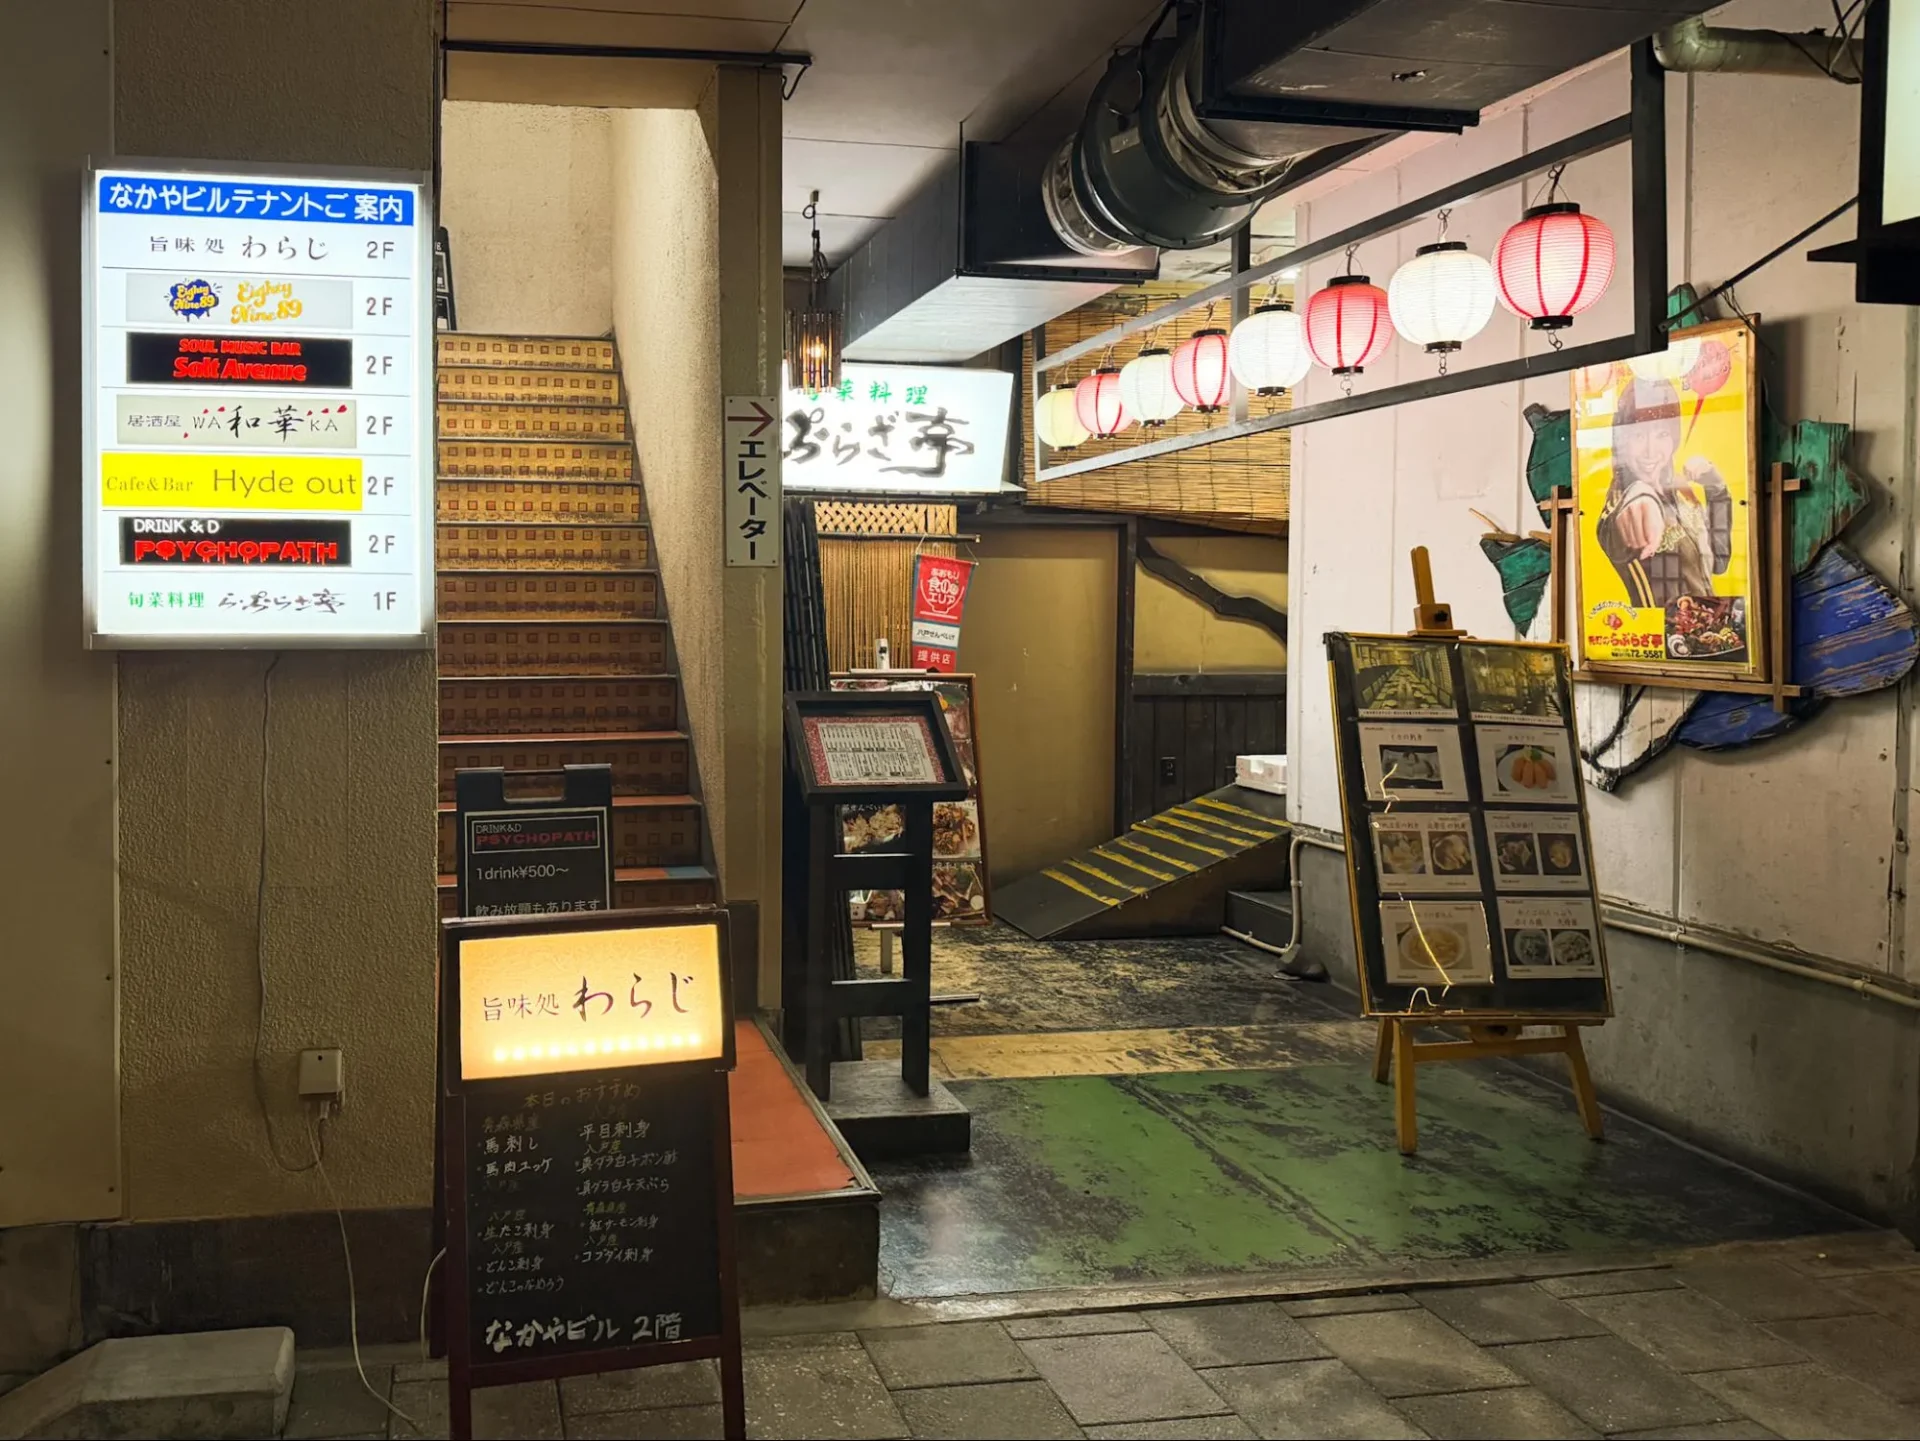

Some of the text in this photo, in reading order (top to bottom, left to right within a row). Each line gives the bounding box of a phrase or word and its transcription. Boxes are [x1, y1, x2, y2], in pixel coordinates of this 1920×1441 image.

[109, 182, 403, 222] なかやビルテナントご案内
[150, 236, 394, 261] 旨味処 わらじ 2F
[276, 300, 303, 319] 89
[366, 297, 393, 316] 2F
[179, 338, 301, 356] SOUL MUSIC BAR
[173, 355, 393, 382] Salt Avenue 2F
[807, 378, 928, 405] 菜料理
[127, 405, 393, 442] 居酒屋 WA 和華 KA 2F
[106, 469, 394, 498] Cafe&Bar Hyde out 2F
[738, 440, 772, 560] エレベーター
[134, 519, 220, 534] DRINK & D
[134, 535, 395, 565] PSYCHOPATH 2F
[128, 592, 205, 608] 旬菜料理
[373, 592, 397, 610] 1F
[917, 649, 951, 665] 提供店
[475, 823, 522, 835] DRINK&D
[476, 831, 596, 847] PSYCHOPATH
[483, 972, 694, 1022] 旨味処 わらじ
[523, 1077, 641, 1109] 本日のおすすめ
[579, 1120, 651, 1140] 平目刺身
[483, 1134, 539, 1155] 馬刺し
[485, 1157, 553, 1178] 馬肉ユッケ
[482, 1221, 556, 1242] 生たこ刺身
[485, 1312, 683, 1353] なかやビル 2階
